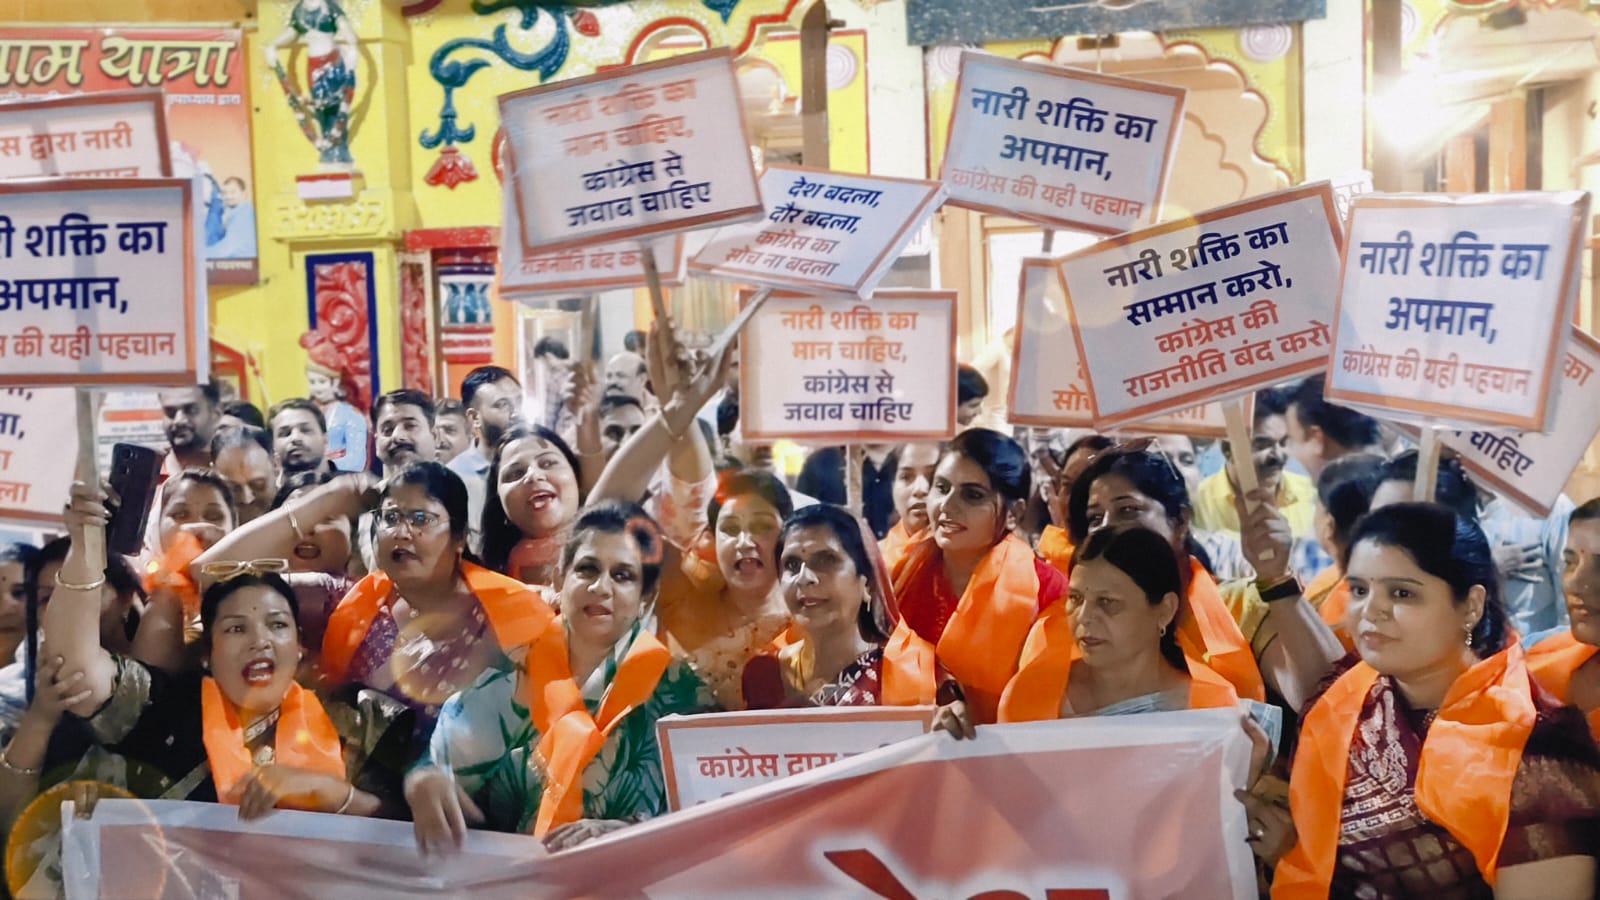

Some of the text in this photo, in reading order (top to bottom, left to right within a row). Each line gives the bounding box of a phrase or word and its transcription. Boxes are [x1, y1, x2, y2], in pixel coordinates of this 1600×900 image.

[100, 37, 236, 86] यात्रा
[81, 121, 133, 150] नारी
[971, 86, 1157, 143] नारी शक्ति का
[581, 150, 684, 192] कांग्रेस से
[1000, 135, 1112, 181] अपमान,
[565, 180, 711, 227] जवाब चाहिए
[788, 177, 883, 208] देश बदला,
[952, 166, 1144, 219] कांग्रेस की यही पहचान
[25, 213, 108, 257] शक्ति
[116, 222, 167, 254] का
[769, 202, 862, 234] दौर बदला,
[726, 245, 840, 278] सोच ना बदला
[755, 229, 841, 255] कांग्रेस का
[1103, 222, 1289, 288] नारी शक्ति का
[1360, 230, 1551, 280] नारी शक्ति का
[0, 278, 128, 314] अपमान,
[1123, 260, 1292, 327] सम्मान करो,
[781, 304, 919, 330] नारी शक्ति का
[1155, 299, 1279, 353] कांग्रेस की
[1385, 297, 1497, 344] अपमान,
[13, 326, 44, 357] की
[48, 326, 91, 360] यही
[97, 333, 176, 360] पहचान
[792, 335, 908, 363] मान चाहिए,
[1123, 349, 1227, 398] राजनीति
[1230, 340, 1275, 365] बंद
[1276, 320, 1331, 354] करो
[803, 368, 894, 394] कांग्रेस से
[1342, 344, 1532, 395] कांग्रेस की यही पहचान
[1563, 352, 1594, 386] का
[783, 397, 913, 423] जवाब चाहिए
[1469, 430, 1534, 477] चाहिए
[696, 747, 778, 778] कांग्रेस
